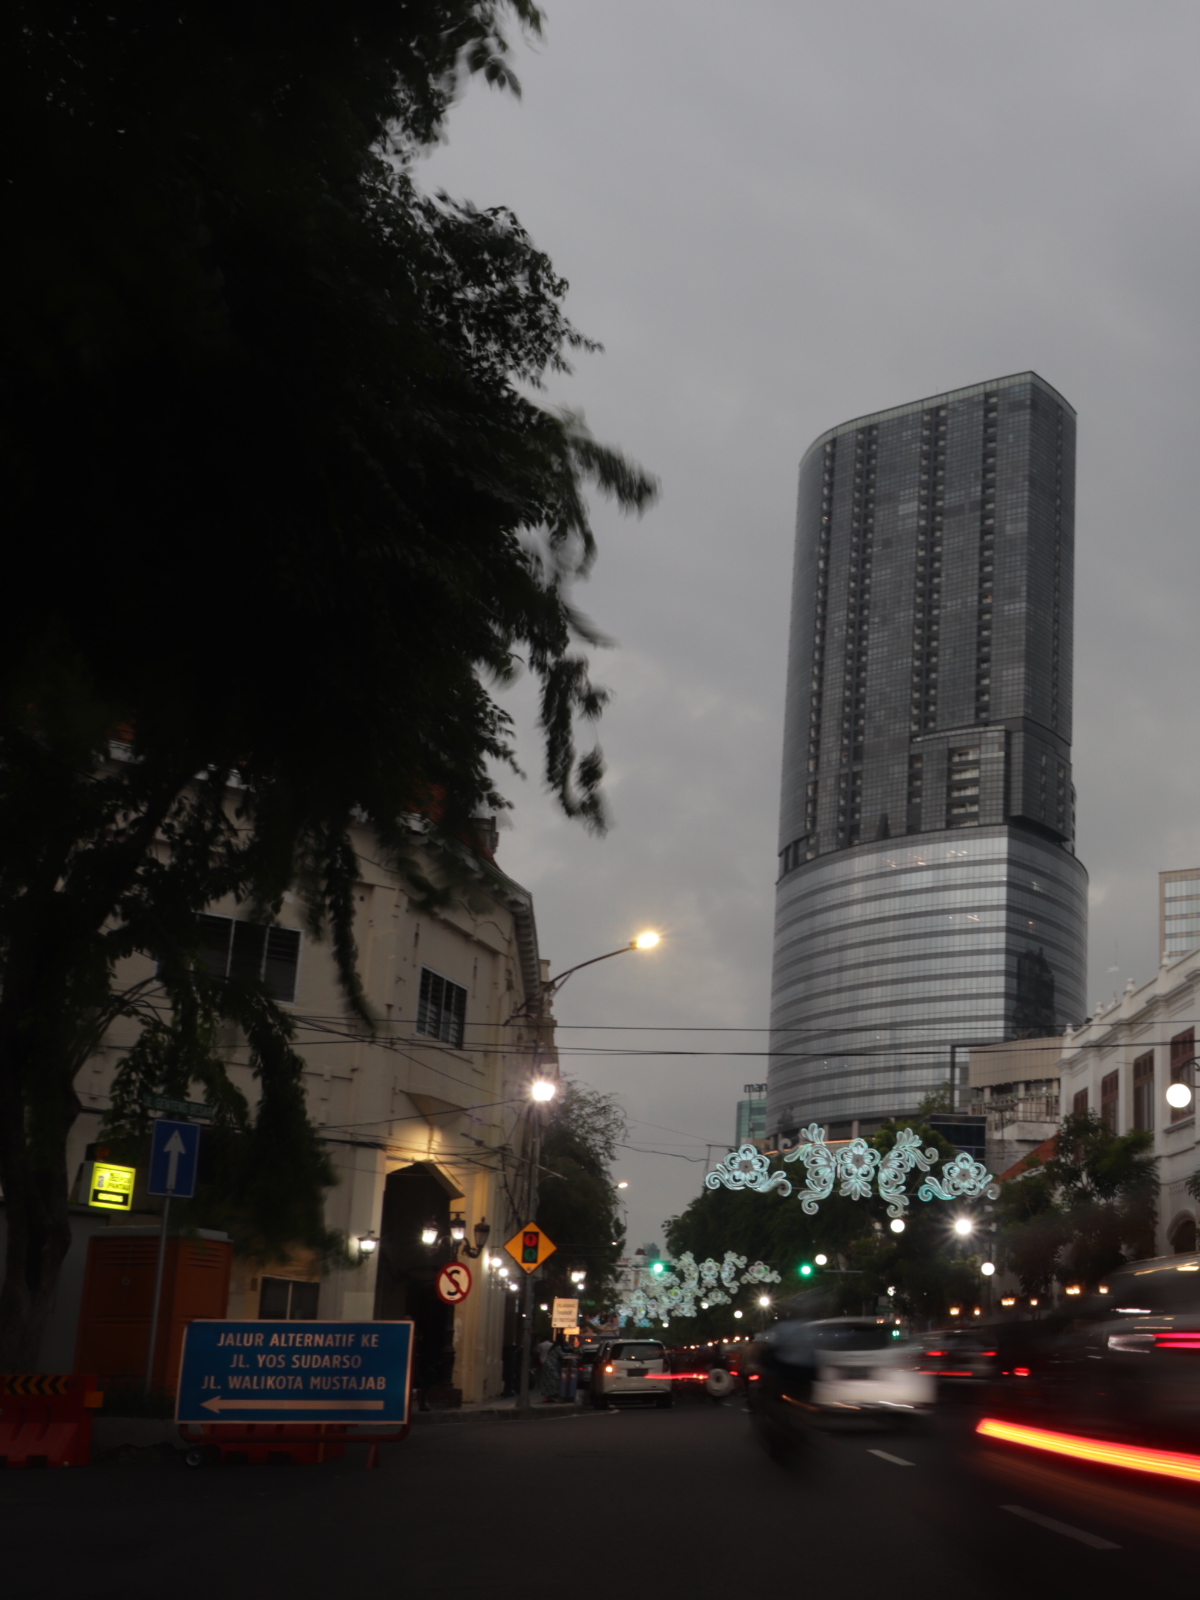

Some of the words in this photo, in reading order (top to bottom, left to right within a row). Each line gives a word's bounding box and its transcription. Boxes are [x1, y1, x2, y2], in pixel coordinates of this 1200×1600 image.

[217, 1332, 264, 1347] JALUR
[269, 1333, 355, 1348] ALTERNATIF
[361, 1334, 379, 1348] KE
[229, 1354, 250, 1368] JL.
[257, 1354, 286, 1368] YOS
[291, 1354, 362, 1369] SUDARSO
[201, 1375, 222, 1390] JL.
[228, 1375, 303, 1390] WALIKOTA
[309, 1375, 387, 1390] MUSTAJAB
